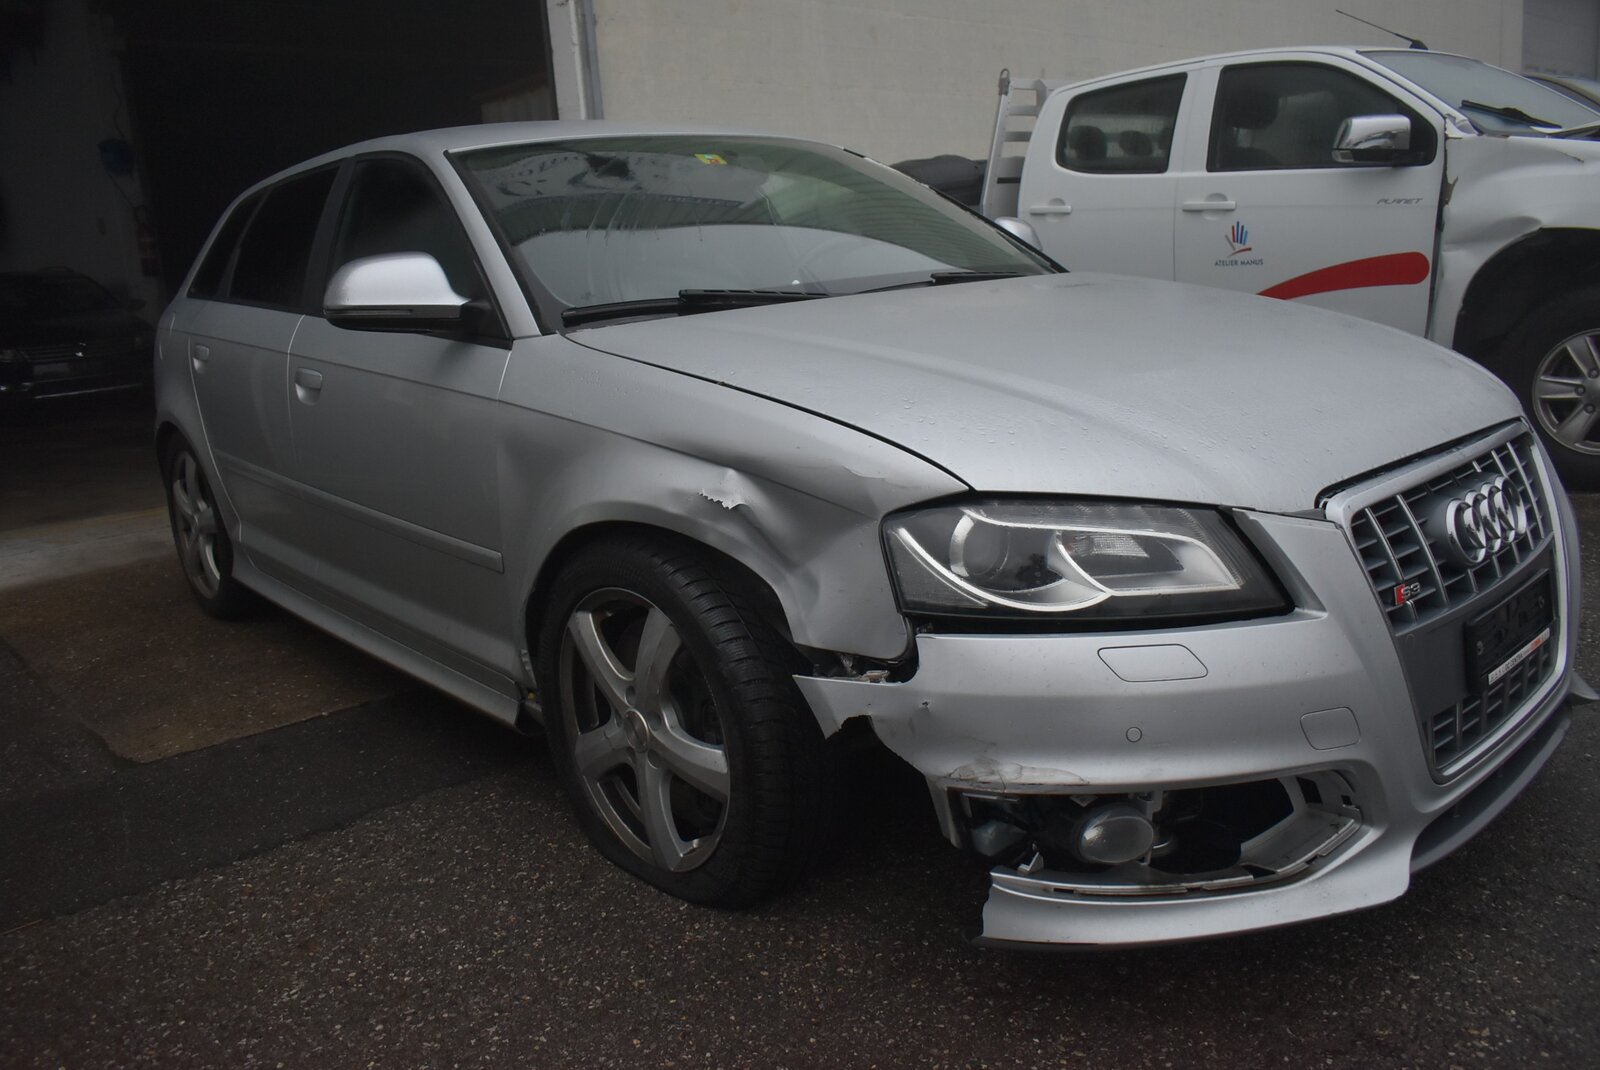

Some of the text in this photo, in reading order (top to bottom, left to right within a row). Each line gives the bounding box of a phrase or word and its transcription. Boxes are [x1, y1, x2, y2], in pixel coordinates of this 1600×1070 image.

[1214, 258, 1264, 267] ATELIER MANUS
[1401, 582, 1421, 599] S3
